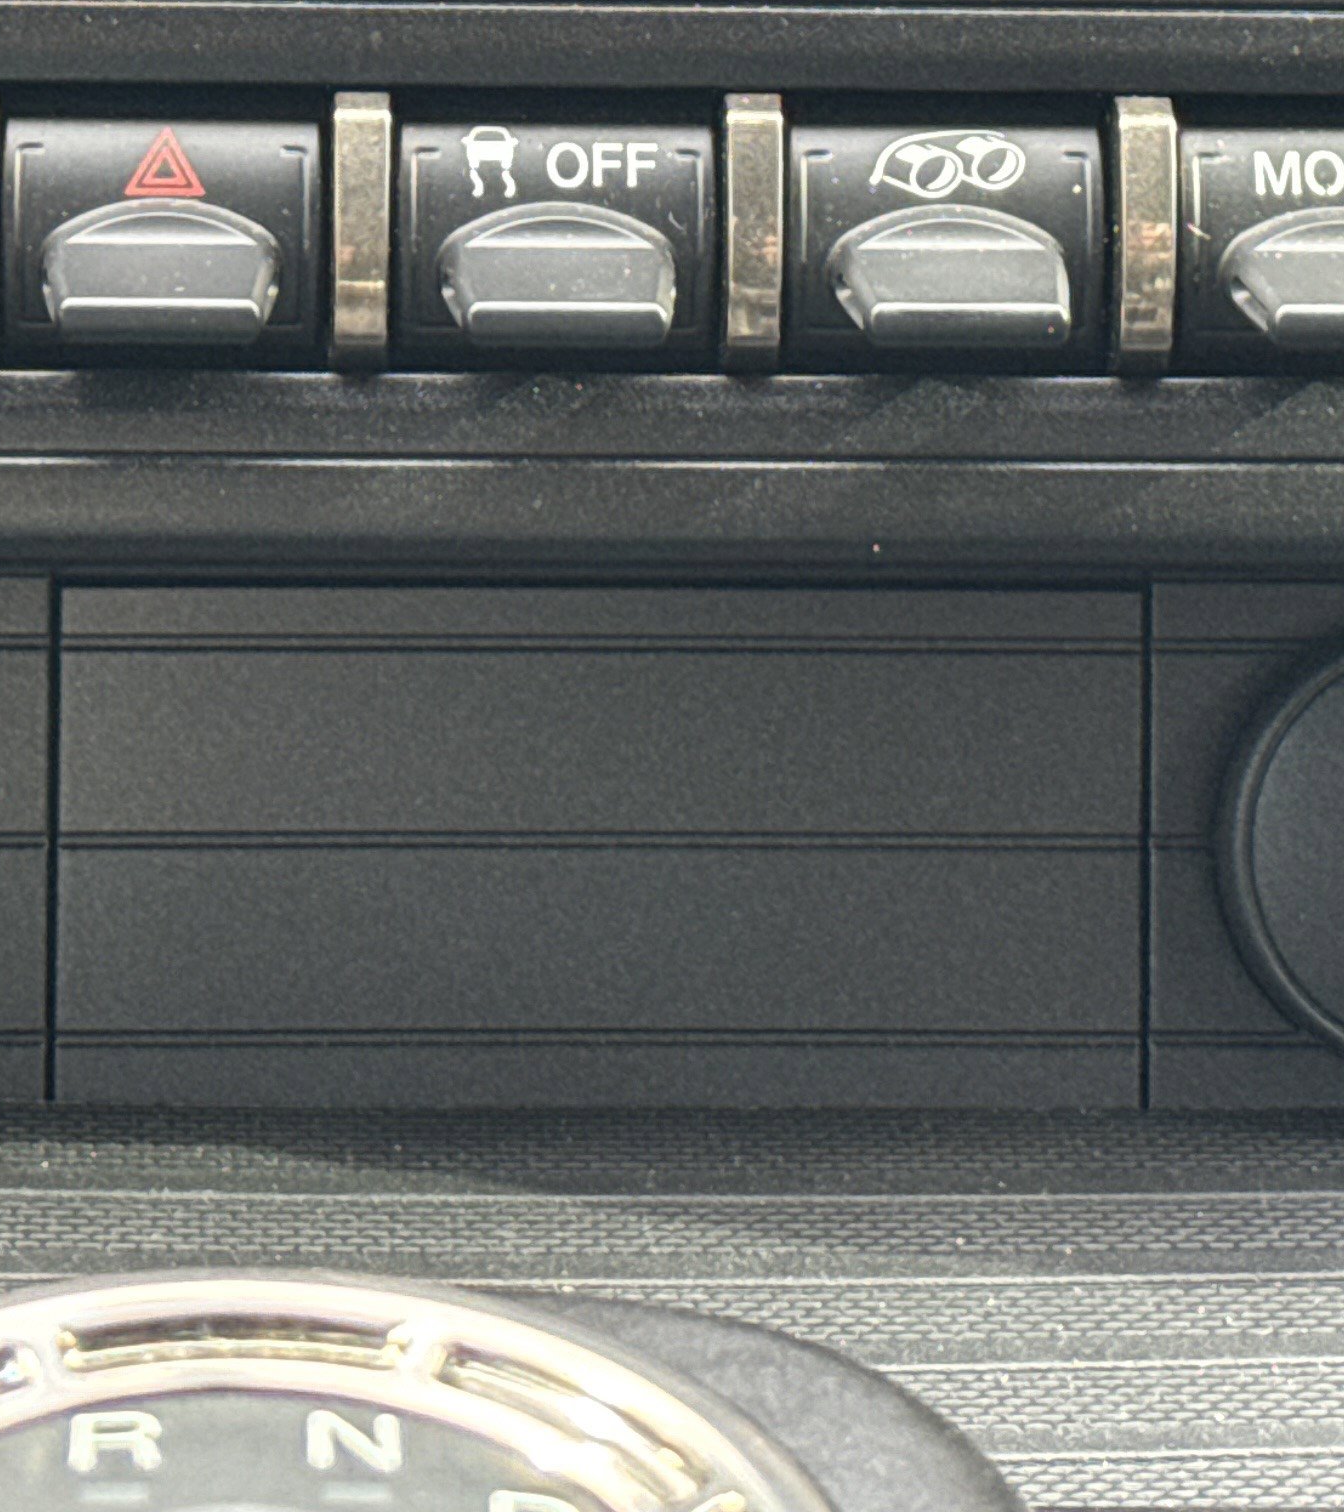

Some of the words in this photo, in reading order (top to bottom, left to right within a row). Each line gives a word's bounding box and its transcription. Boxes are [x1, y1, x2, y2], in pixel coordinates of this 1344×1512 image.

[546, 141, 658, 188] OFF
[68, 1410, 162, 1473] R
[306, 1409, 403, 1473] N
